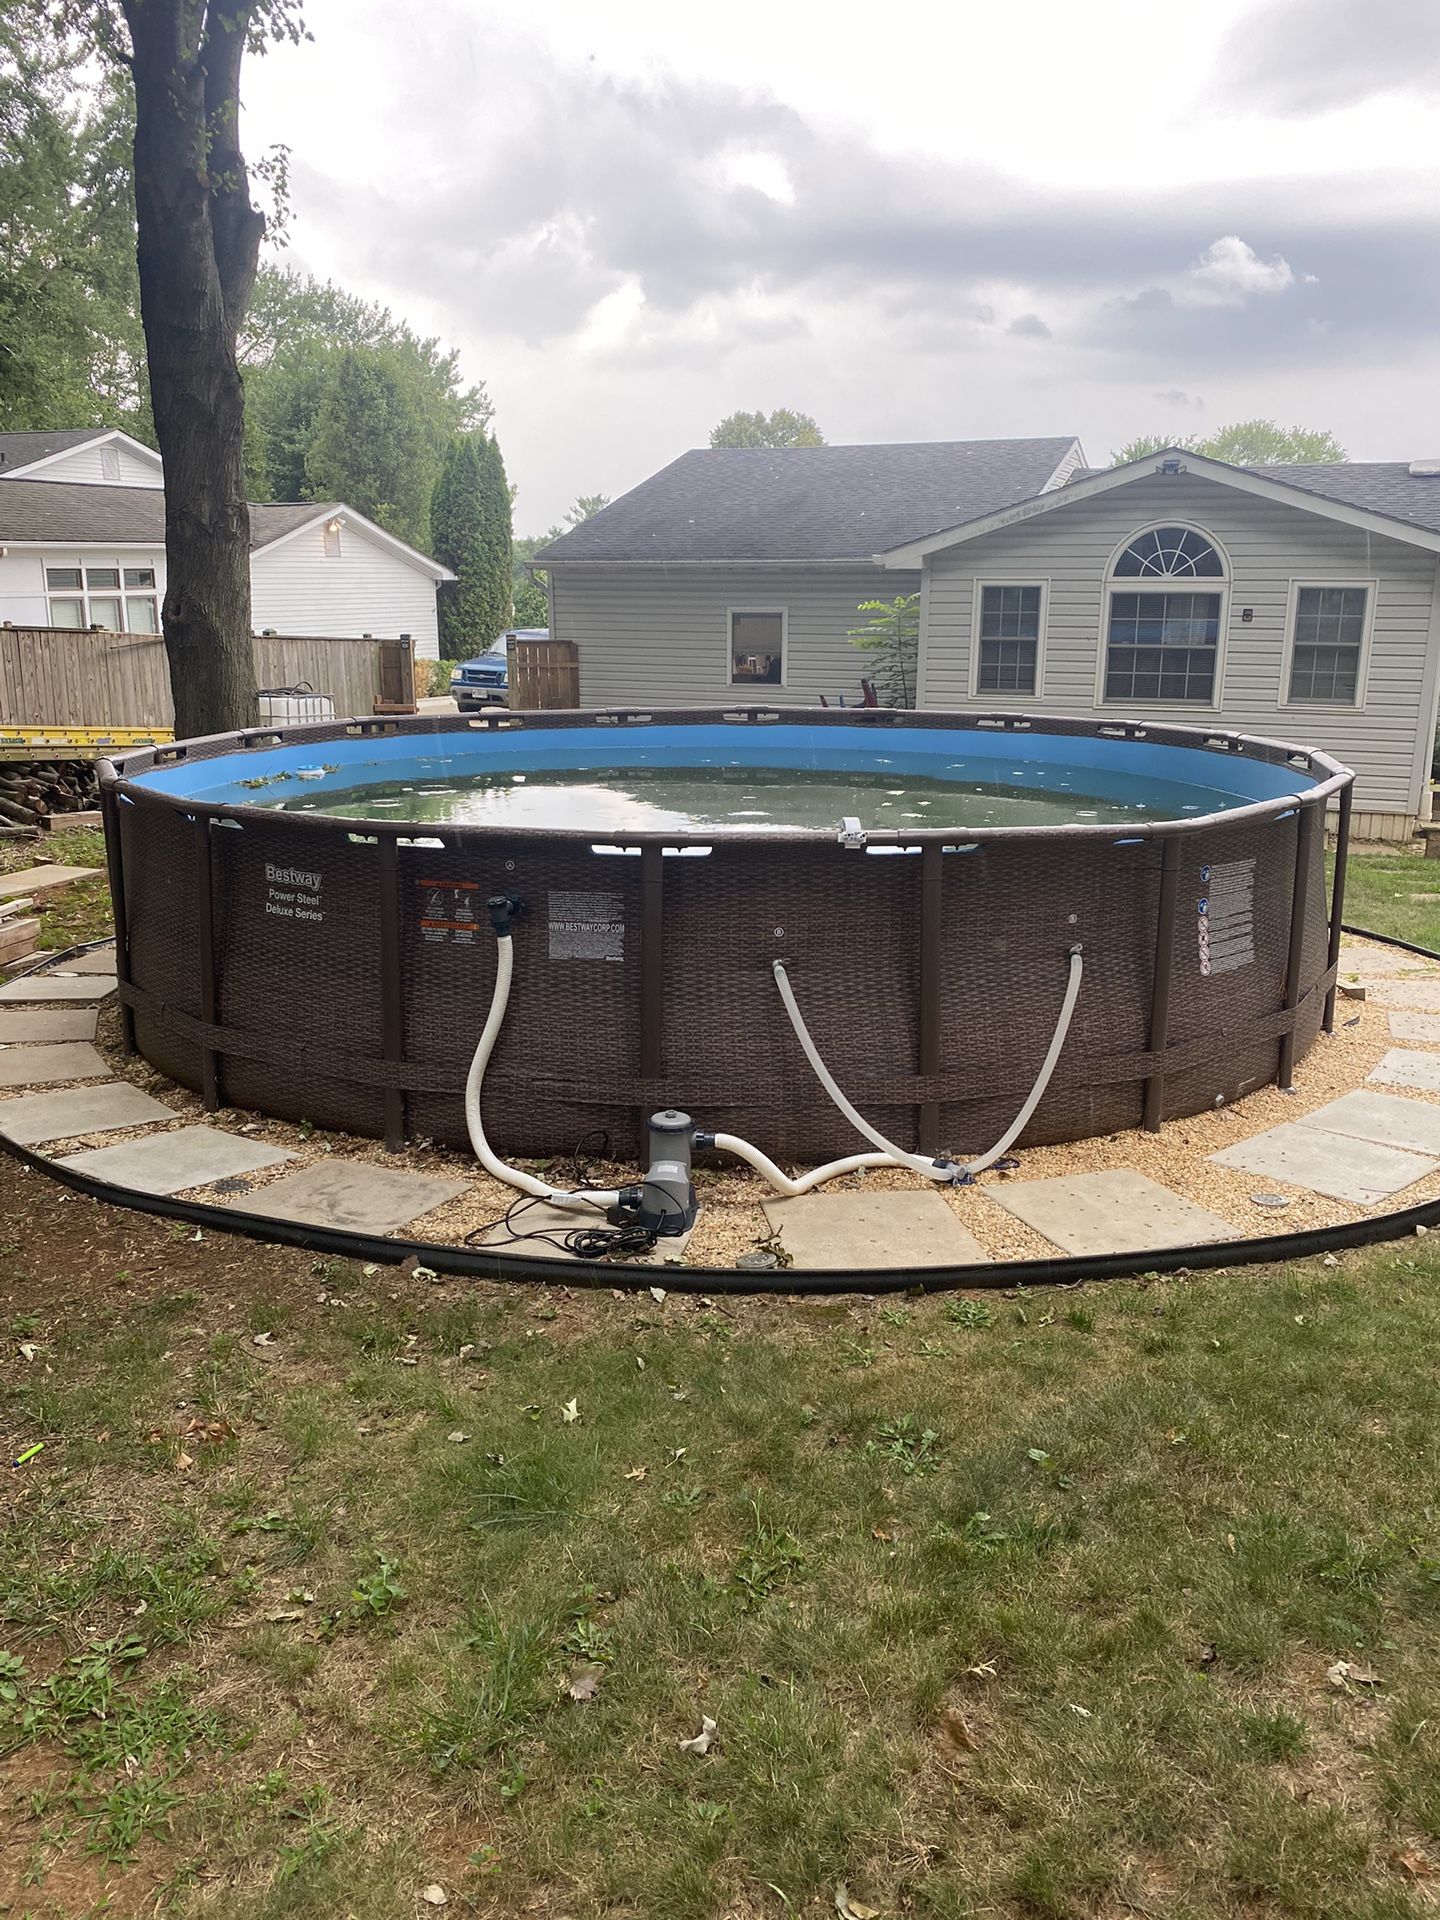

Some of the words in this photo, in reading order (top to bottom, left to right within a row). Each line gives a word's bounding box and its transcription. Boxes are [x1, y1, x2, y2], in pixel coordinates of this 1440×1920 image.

[265, 864, 321, 891] Bestway
[269, 889, 295, 902] Power
[297, 893, 320, 905] Steel
[266, 903, 293, 916] Deluxe
[295, 908, 323, 921] Series
[549, 922, 625, 933] WWW.BESTWAYCORP.COM
